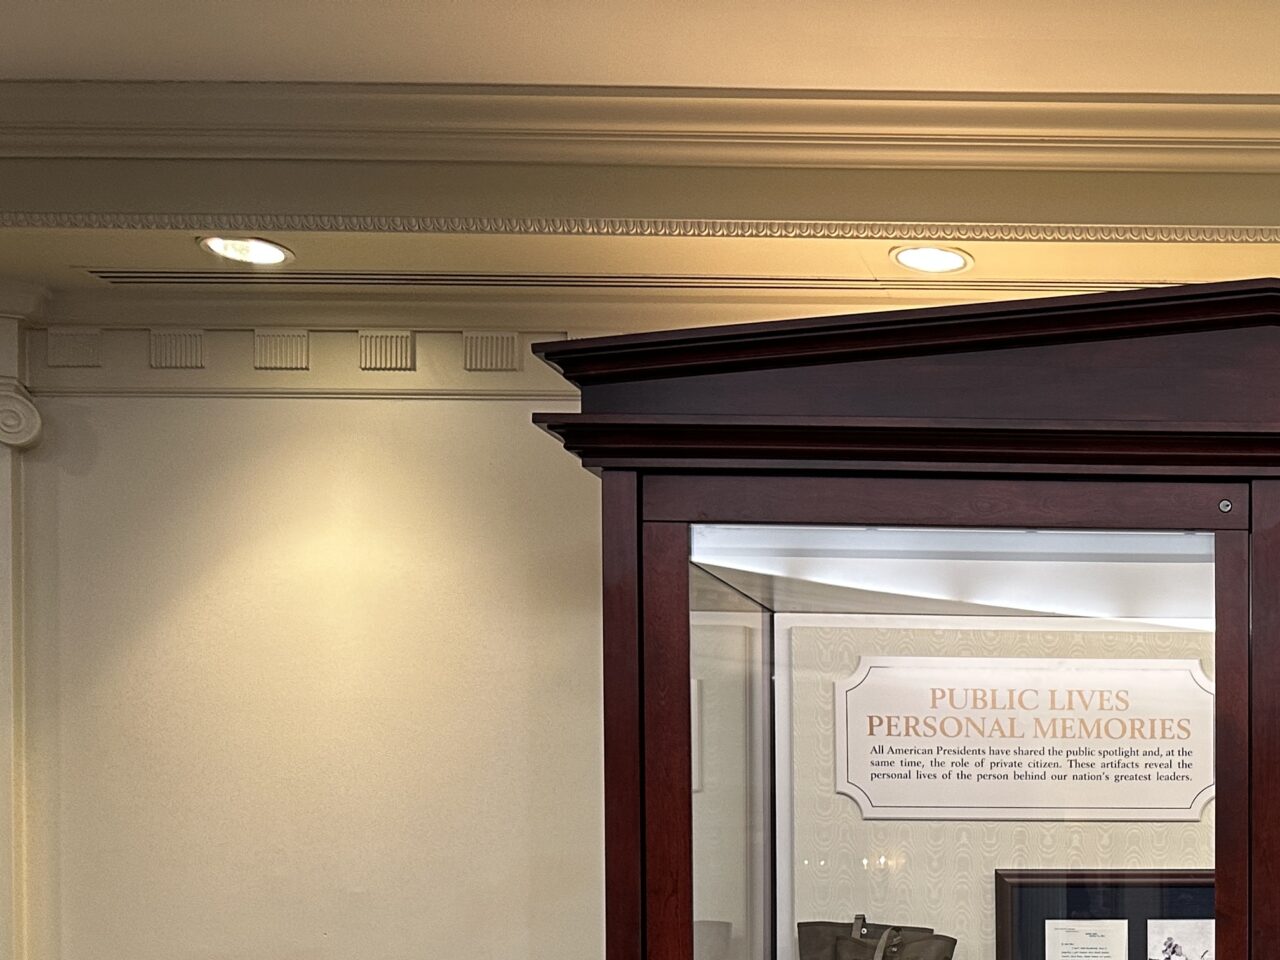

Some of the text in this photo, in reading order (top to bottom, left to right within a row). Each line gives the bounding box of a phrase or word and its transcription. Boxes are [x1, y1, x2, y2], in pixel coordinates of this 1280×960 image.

[930, 688, 1130, 711] PUBLIC LIVES
[866, 715, 1191, 740] PERSONAL MEMORIES
[870, 745, 1193, 759] All American Presidents have shared the public spotlight and, at the
[900, 759, 925, 769] time,
[930, 758, 945, 767] the
[950, 759, 970, 767] role
[974, 759, 986, 768] of
[989, 760, 1023, 771] private
[1028, 759, 1062, 769] citizen.
[1067, 759, 1096, 769] These
[1100, 759, 1139, 769] artifacts
[1144, 760, 1172, 769] reveal
[1177, 760, 1193, 769] the
[870, 770, 1192, 783] personal lives of the person behind our nation's greatest leaders.
